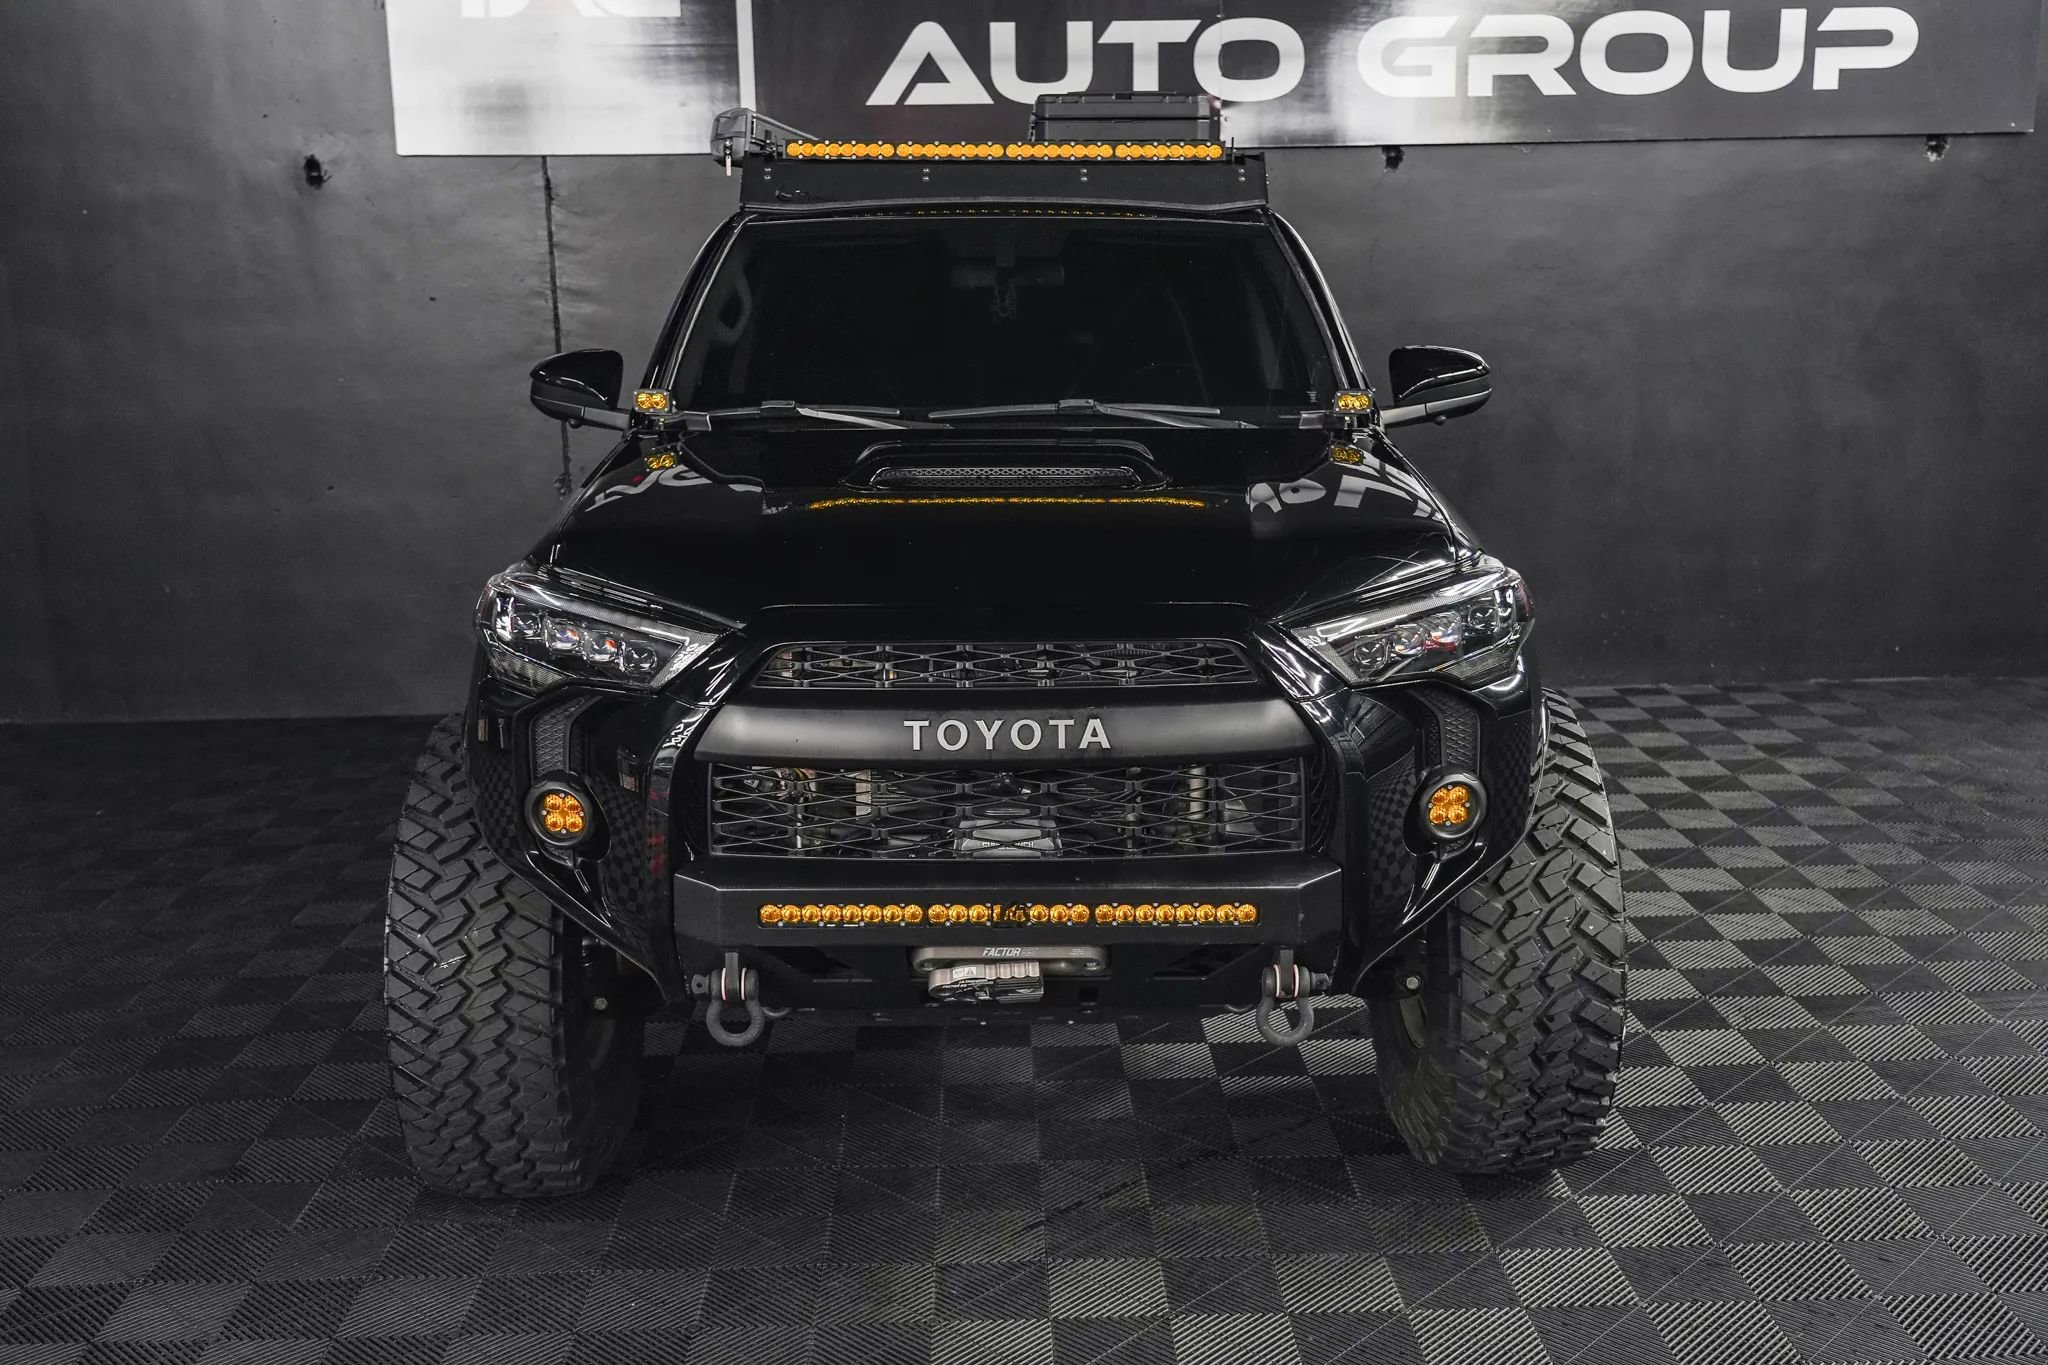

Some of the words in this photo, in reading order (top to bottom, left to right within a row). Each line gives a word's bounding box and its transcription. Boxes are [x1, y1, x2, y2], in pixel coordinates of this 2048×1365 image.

[866, 17, 1305, 105] AUTO
[1357, 6, 1919, 97] GROUP
[903, 718, 1111, 751] TOYOTA
[982, 947, 1021, 957] FACTOR
